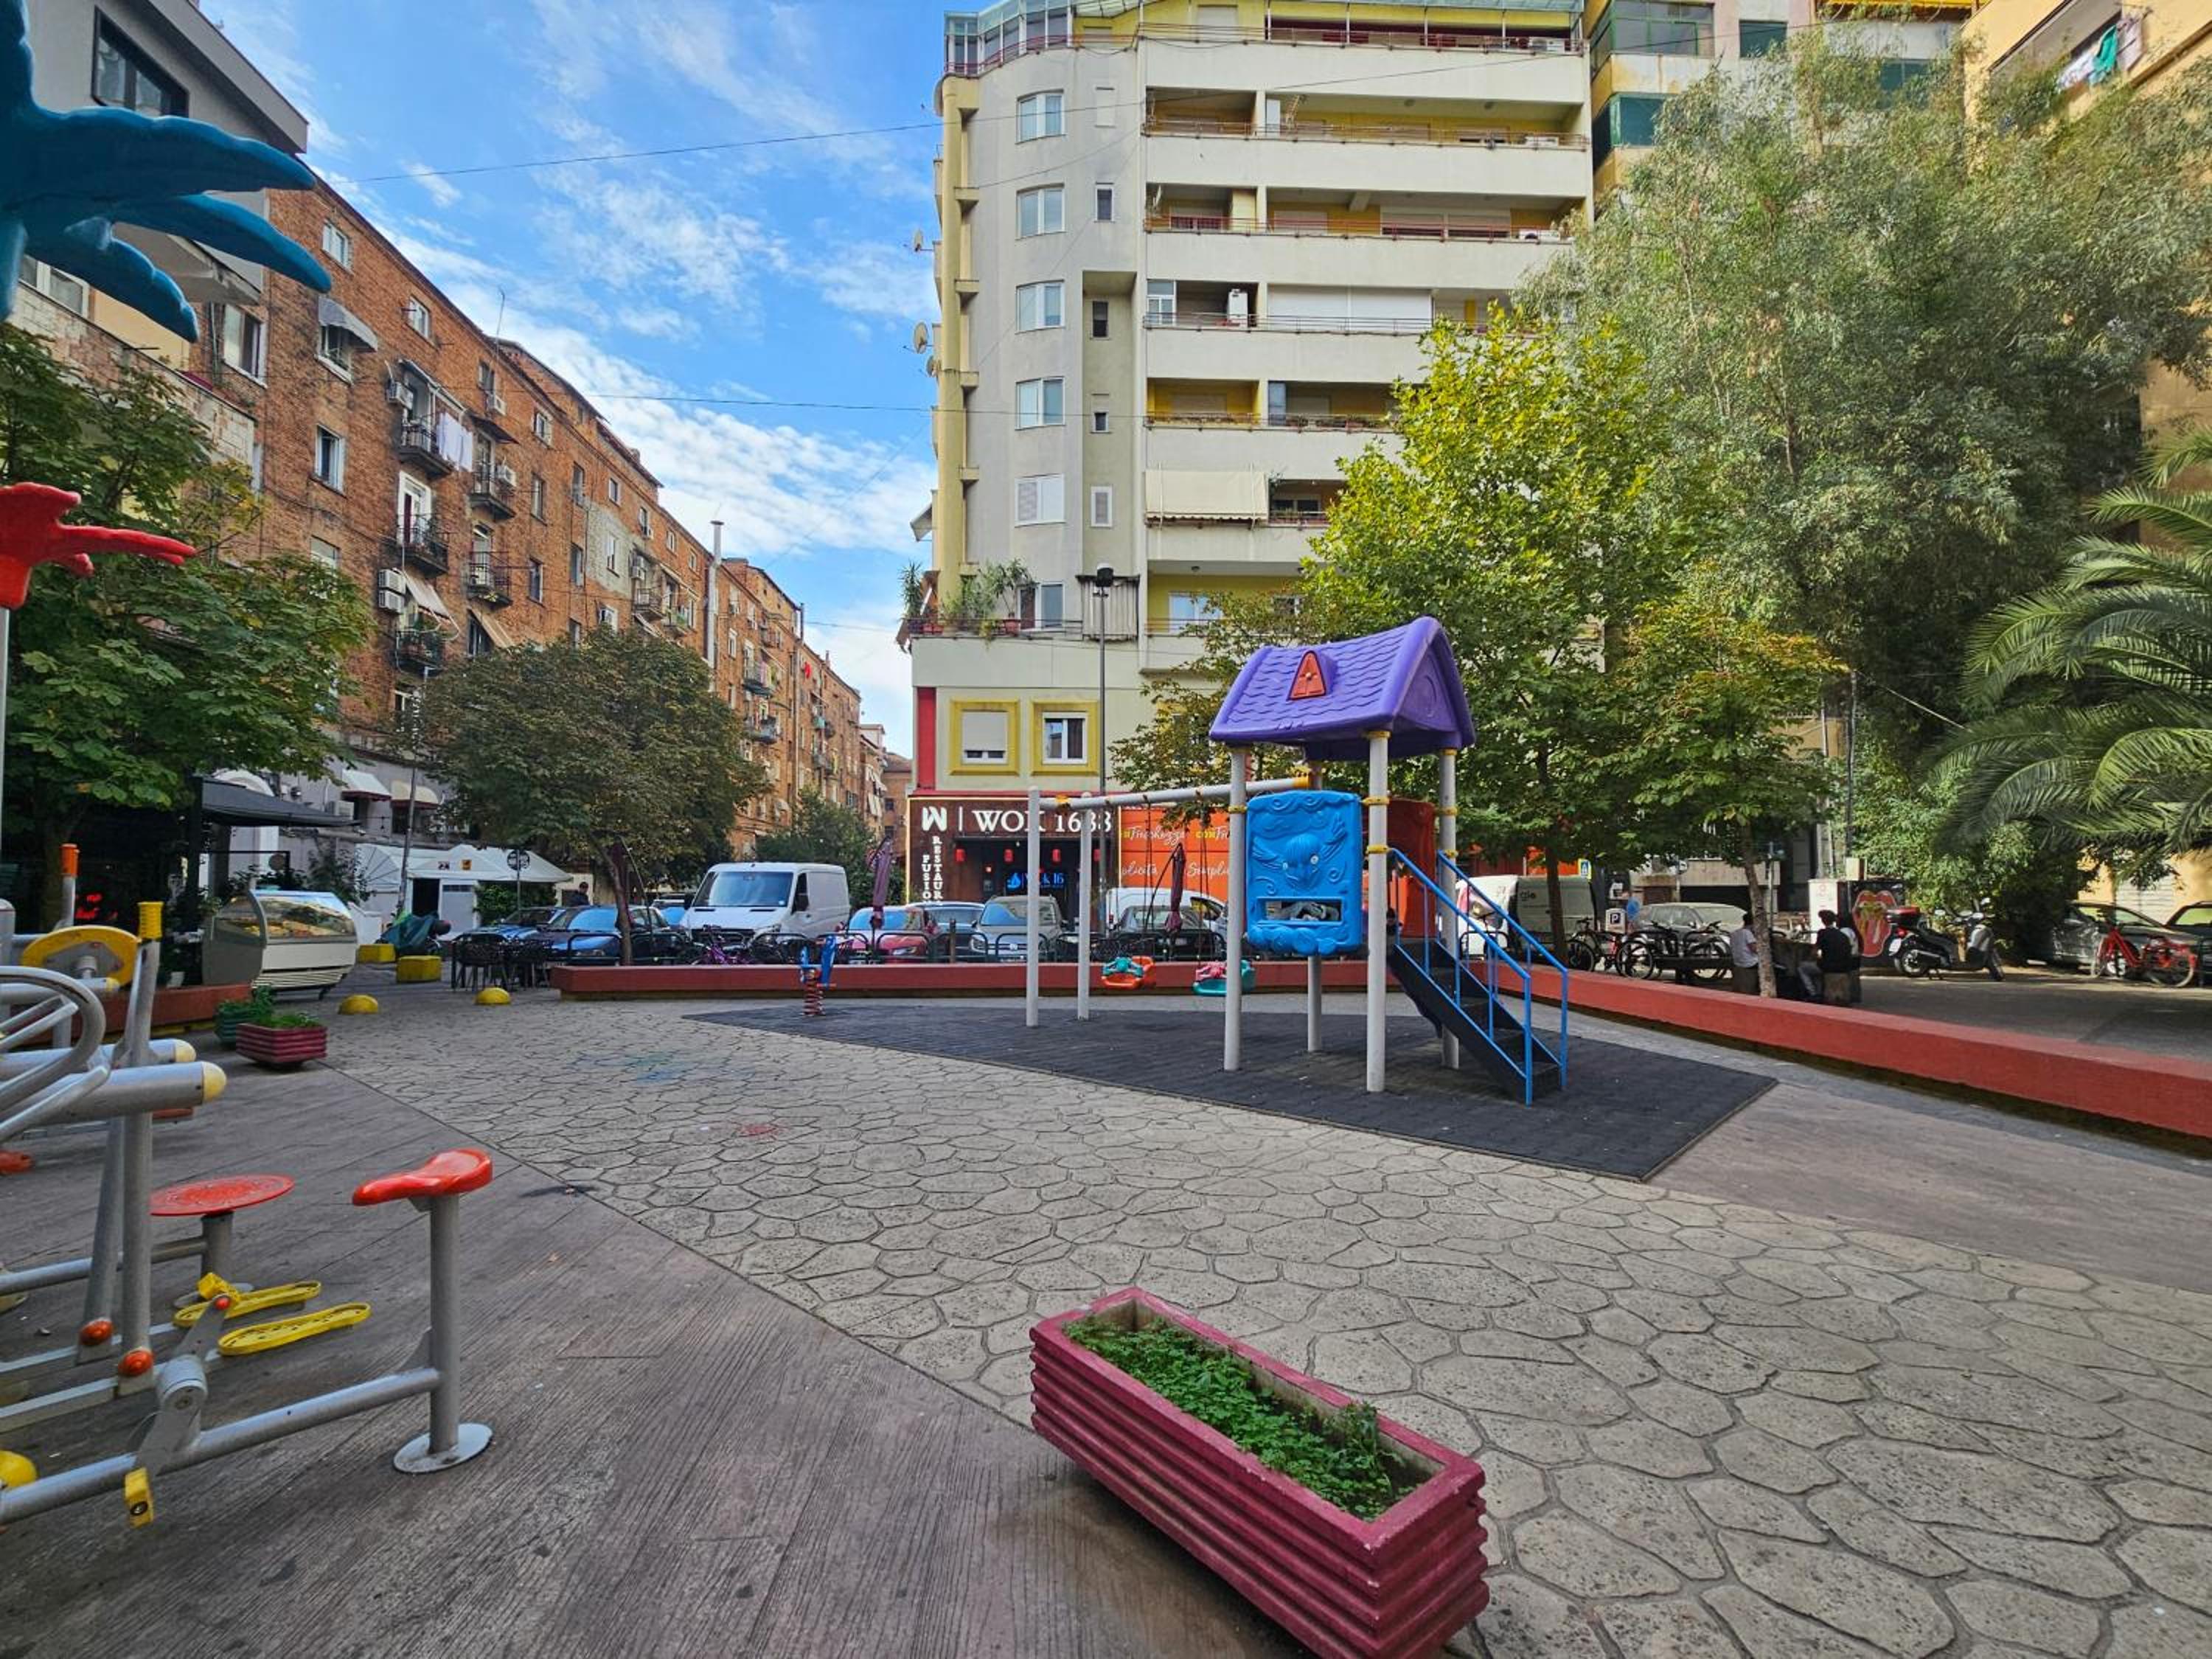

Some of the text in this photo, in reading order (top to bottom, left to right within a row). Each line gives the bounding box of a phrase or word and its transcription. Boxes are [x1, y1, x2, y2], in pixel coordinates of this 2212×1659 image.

[922, 854, 932, 902] FUSIO
[932, 835, 943, 902] RESTAUR
[1611, 914, 1619, 924] P
